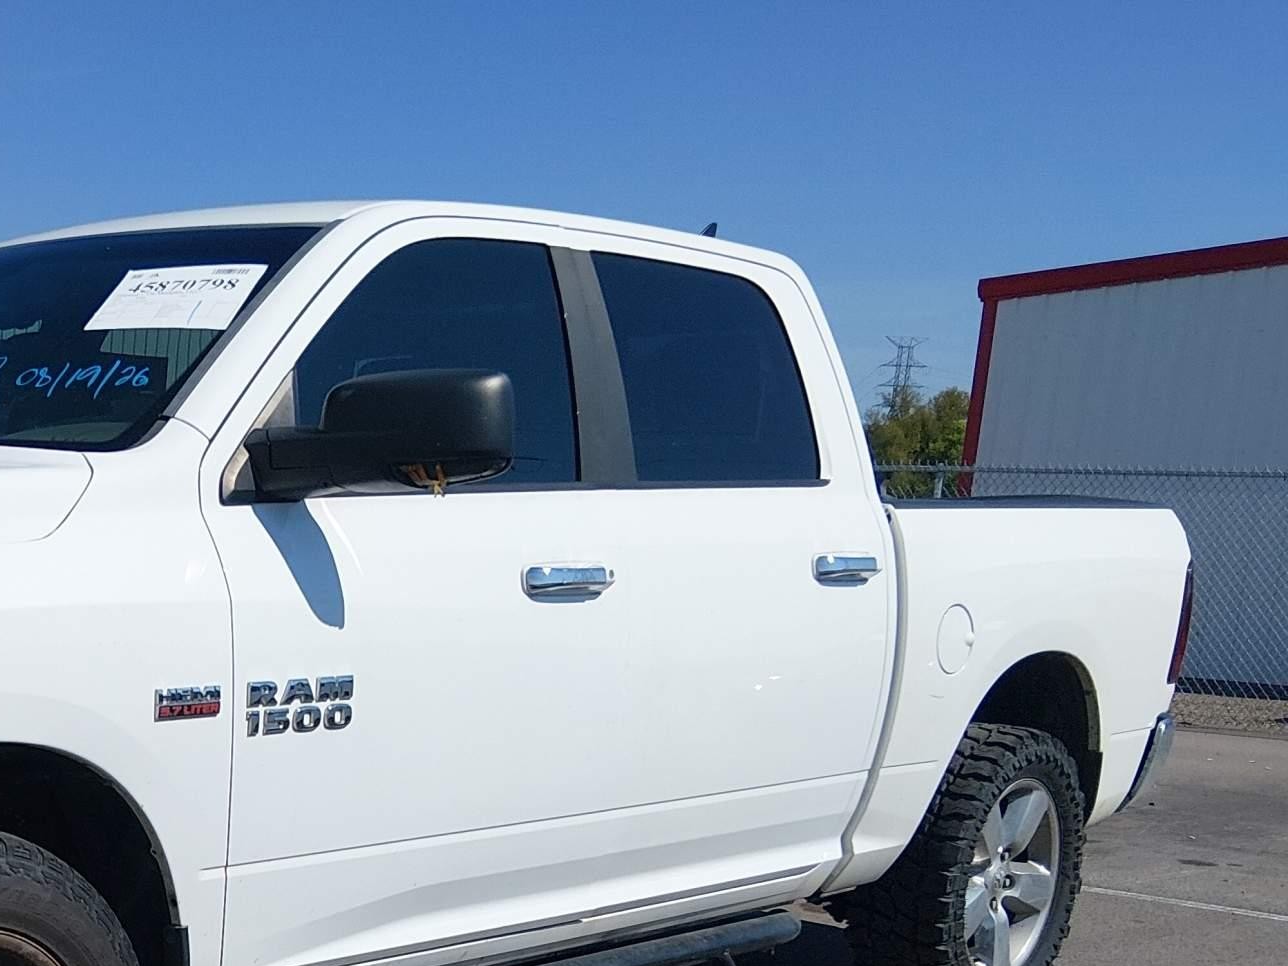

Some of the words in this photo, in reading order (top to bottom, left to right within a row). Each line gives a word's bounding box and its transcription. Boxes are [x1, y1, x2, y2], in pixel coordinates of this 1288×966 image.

[128, 278, 240, 294] 45870798
[15, 359, 150, 400] 08/19/26
[155, 685, 221, 704] HEMI
[246, 675, 354, 709] RAM
[158, 704, 182, 718] 5.7
[183, 702, 220, 716] LITER
[246, 704, 353, 737] 1500
